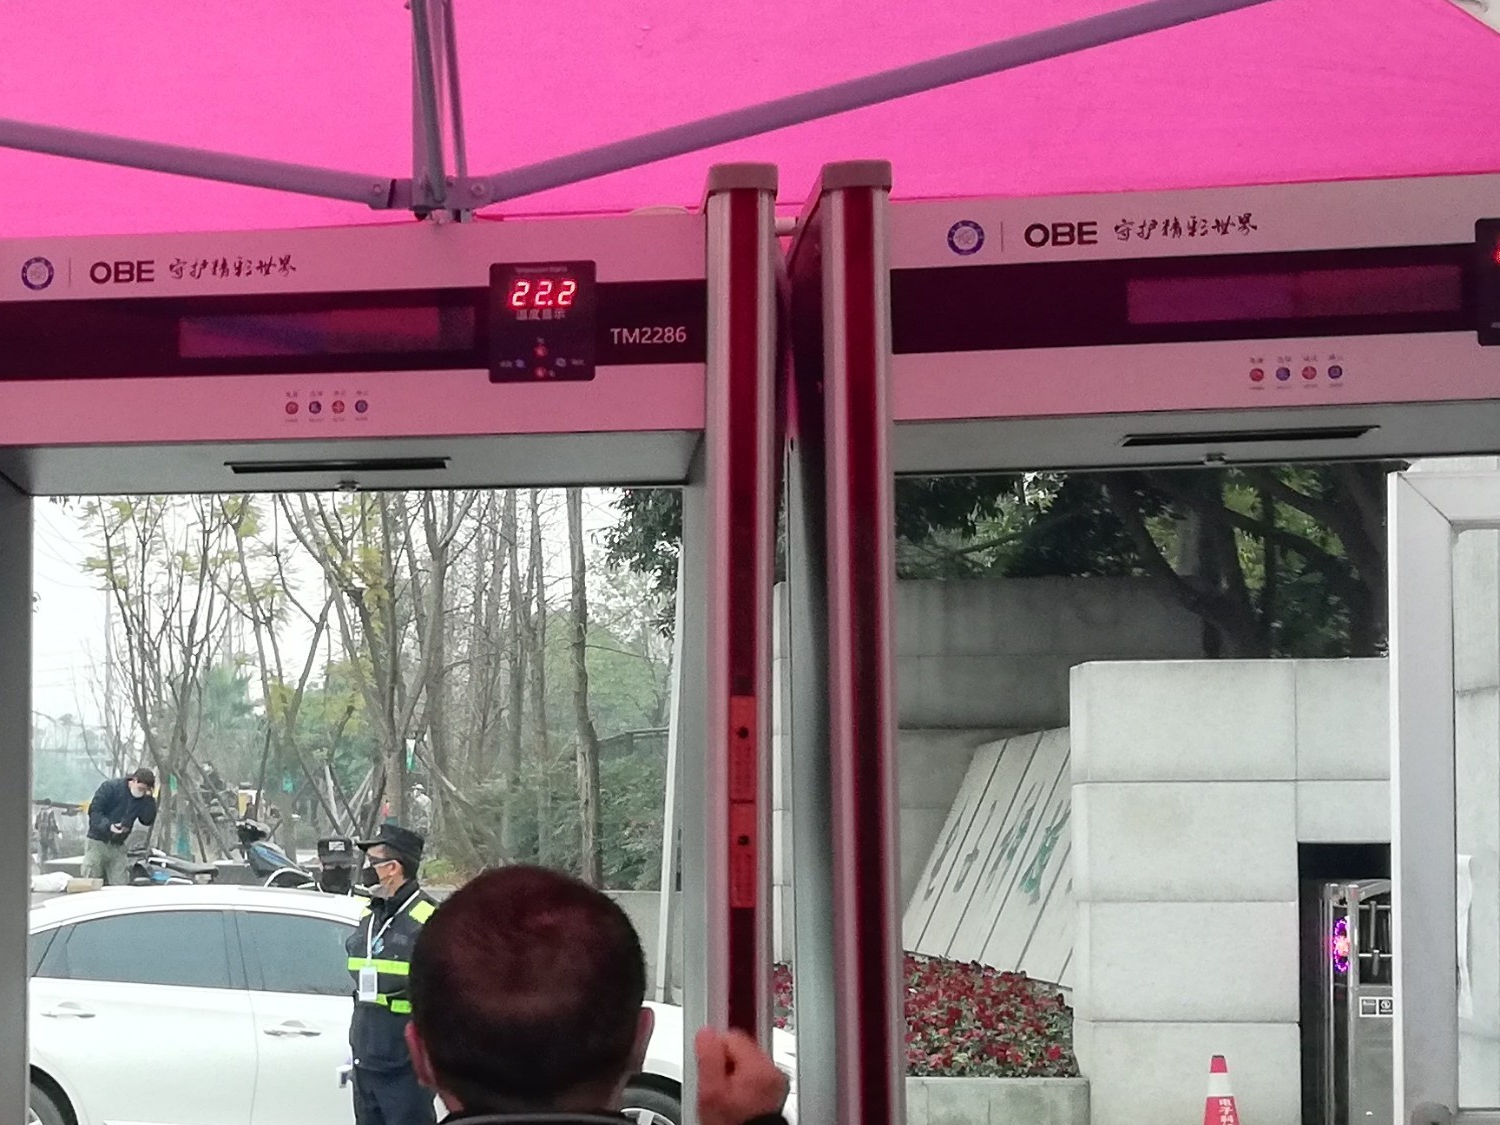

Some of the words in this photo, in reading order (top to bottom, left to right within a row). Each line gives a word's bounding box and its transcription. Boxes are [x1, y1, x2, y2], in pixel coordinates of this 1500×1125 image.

[1024, 221, 1098, 248] OBE
[1114, 212, 1258, 241] 守护精彩世界
[89, 260, 155, 285] OBE
[169, 254, 297, 280] 守护精彩世界
[511, 280, 576, 307] 22.2
[610, 325, 687, 345] TM2286
